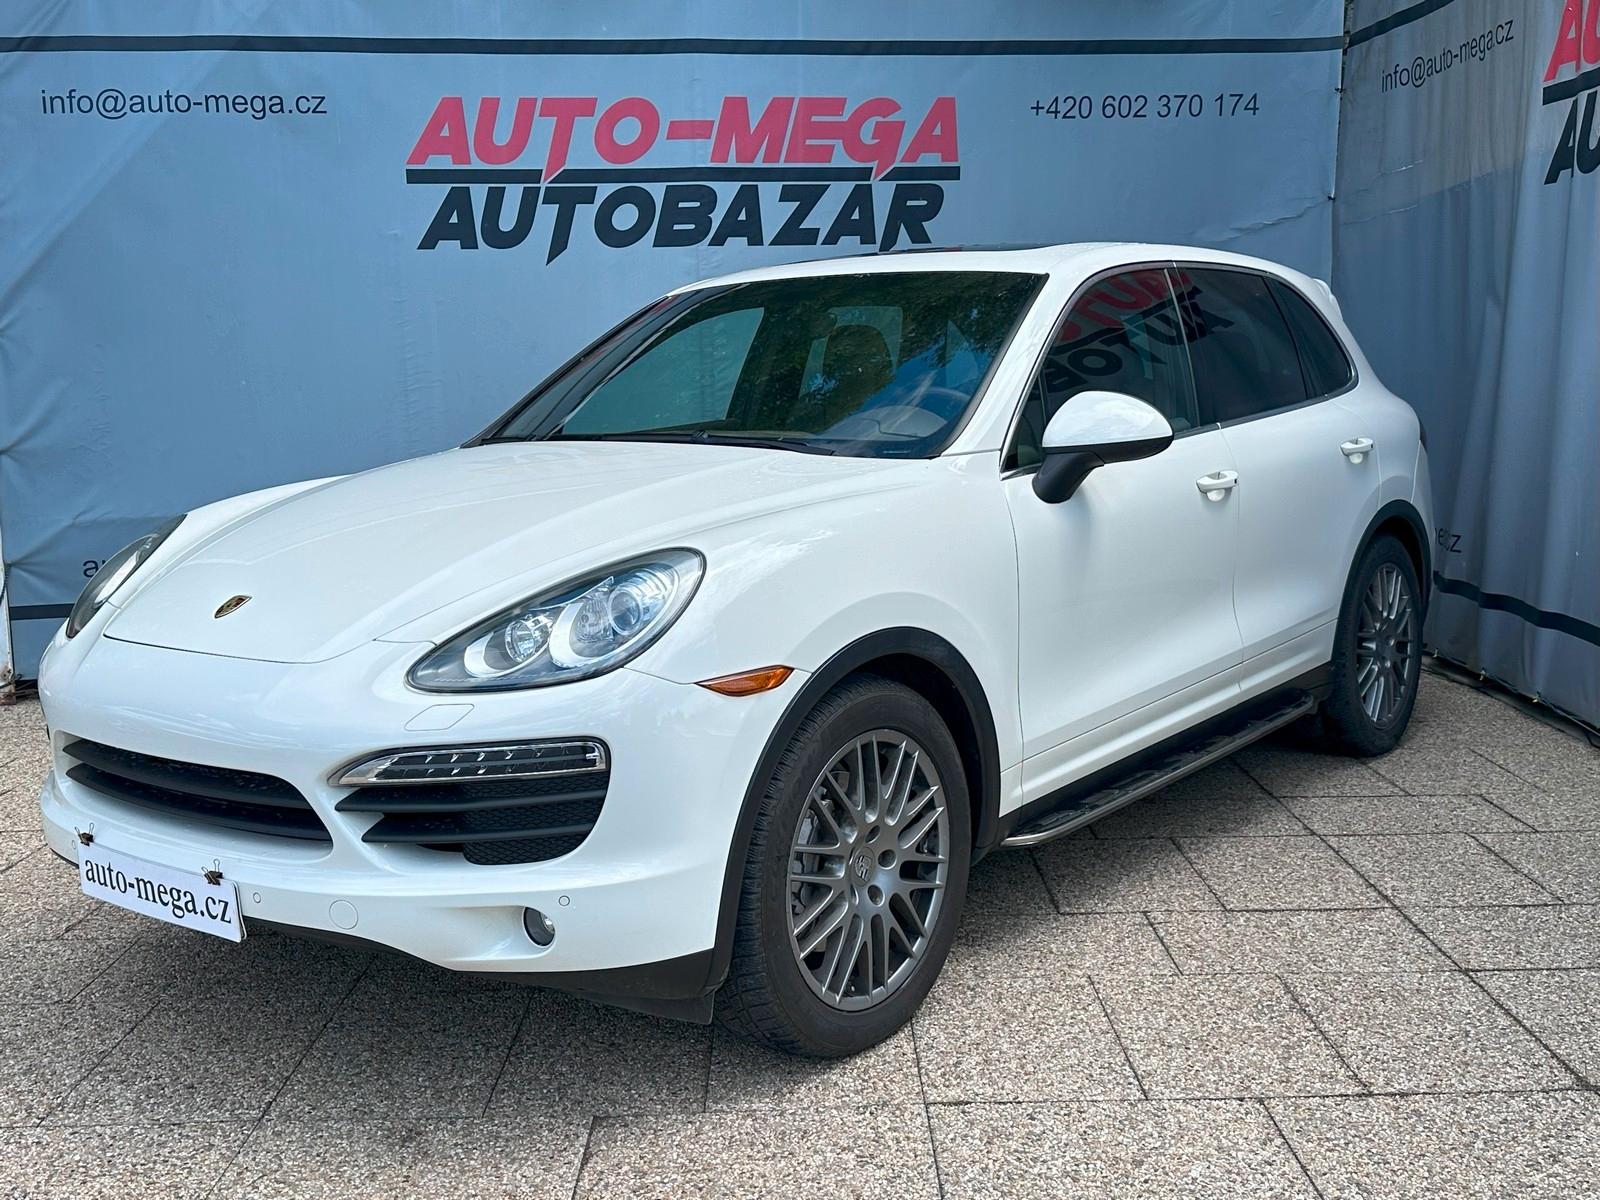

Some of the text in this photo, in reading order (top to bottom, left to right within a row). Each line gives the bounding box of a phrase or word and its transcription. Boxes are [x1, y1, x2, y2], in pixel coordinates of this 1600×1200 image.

[41, 88, 327, 121] info@auto-mega.cz
[1030, 93, 1260, 120] +420 602 370 174
[405, 95, 960, 182] AUTO-MEGA
[418, 182, 945, 265] AUTOBAZAR
[85, 859, 232, 924] auto-mega.cz
